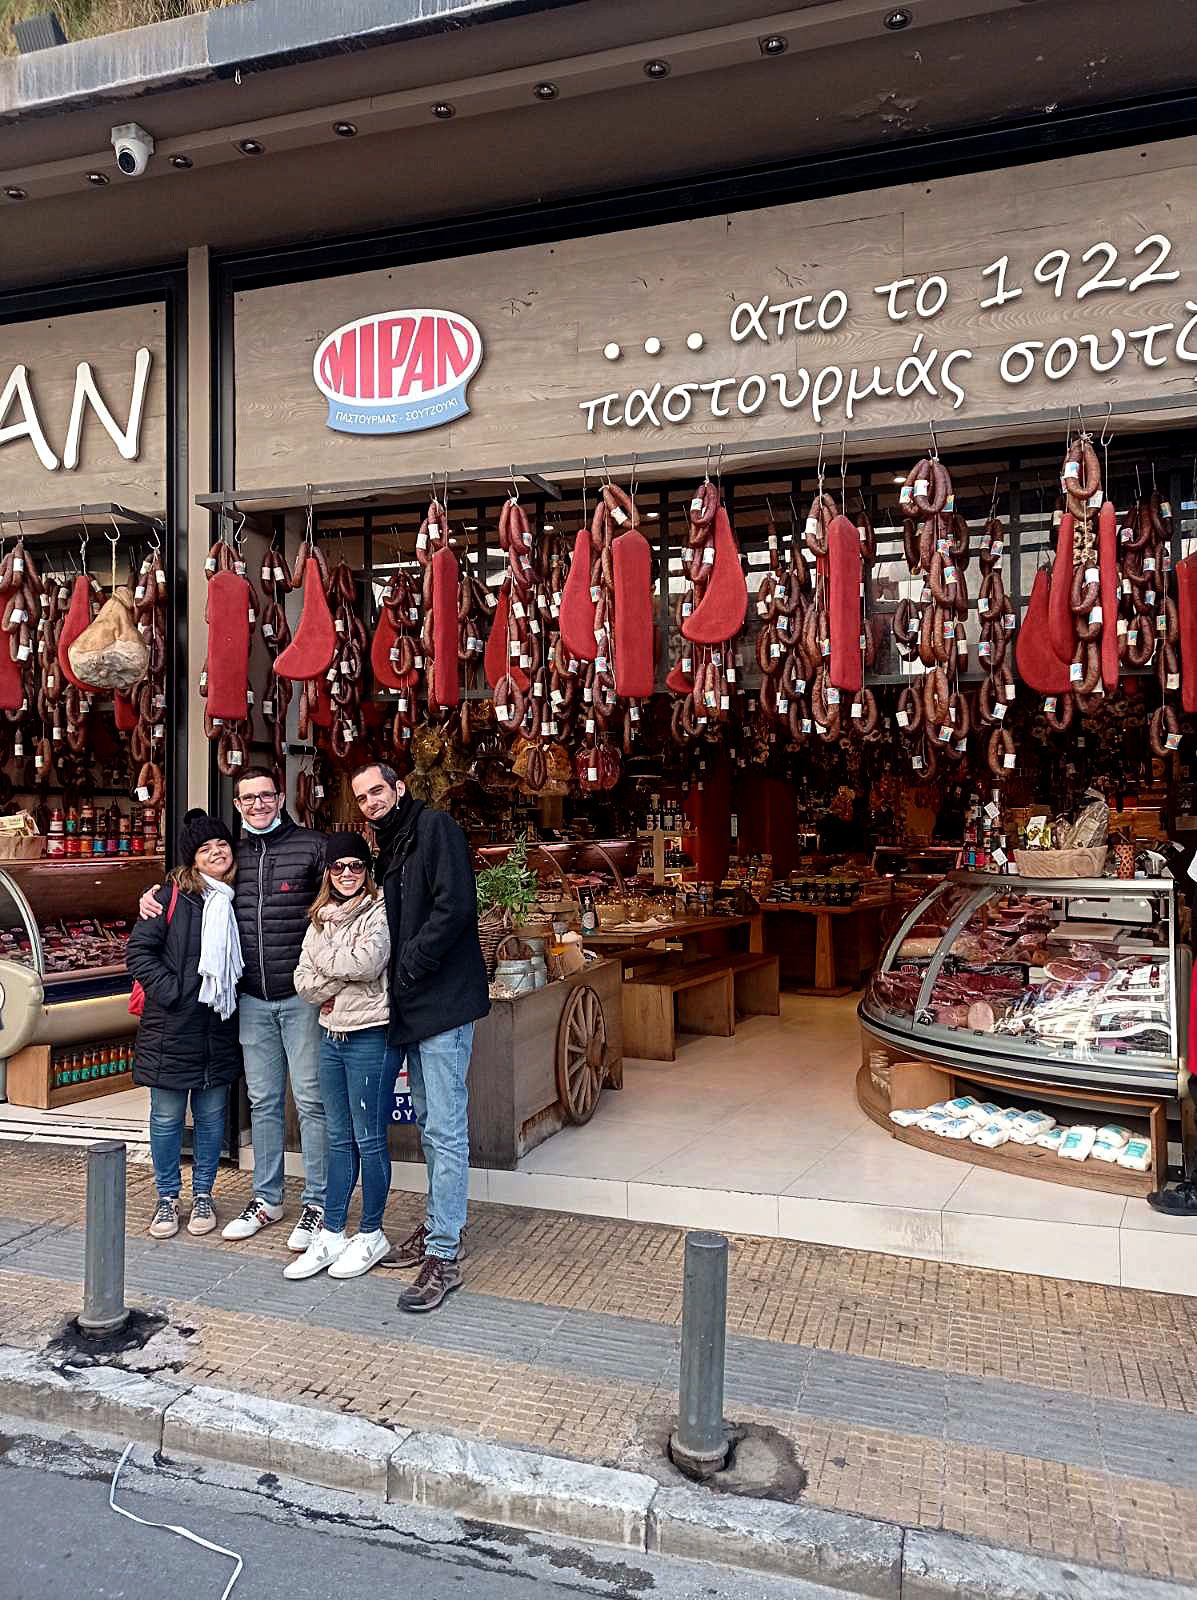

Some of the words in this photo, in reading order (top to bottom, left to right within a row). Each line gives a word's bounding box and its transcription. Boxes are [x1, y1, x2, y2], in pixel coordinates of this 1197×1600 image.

[730, 289, 848, 342] απο
[874, 276, 949, 321] το
[980, 234, 1181, 309] 1922
[335, 410, 397, 425] ΠΑΣΤΟΥΡΜΑΣ
[579, 333, 973, 432] παστουρμάς
